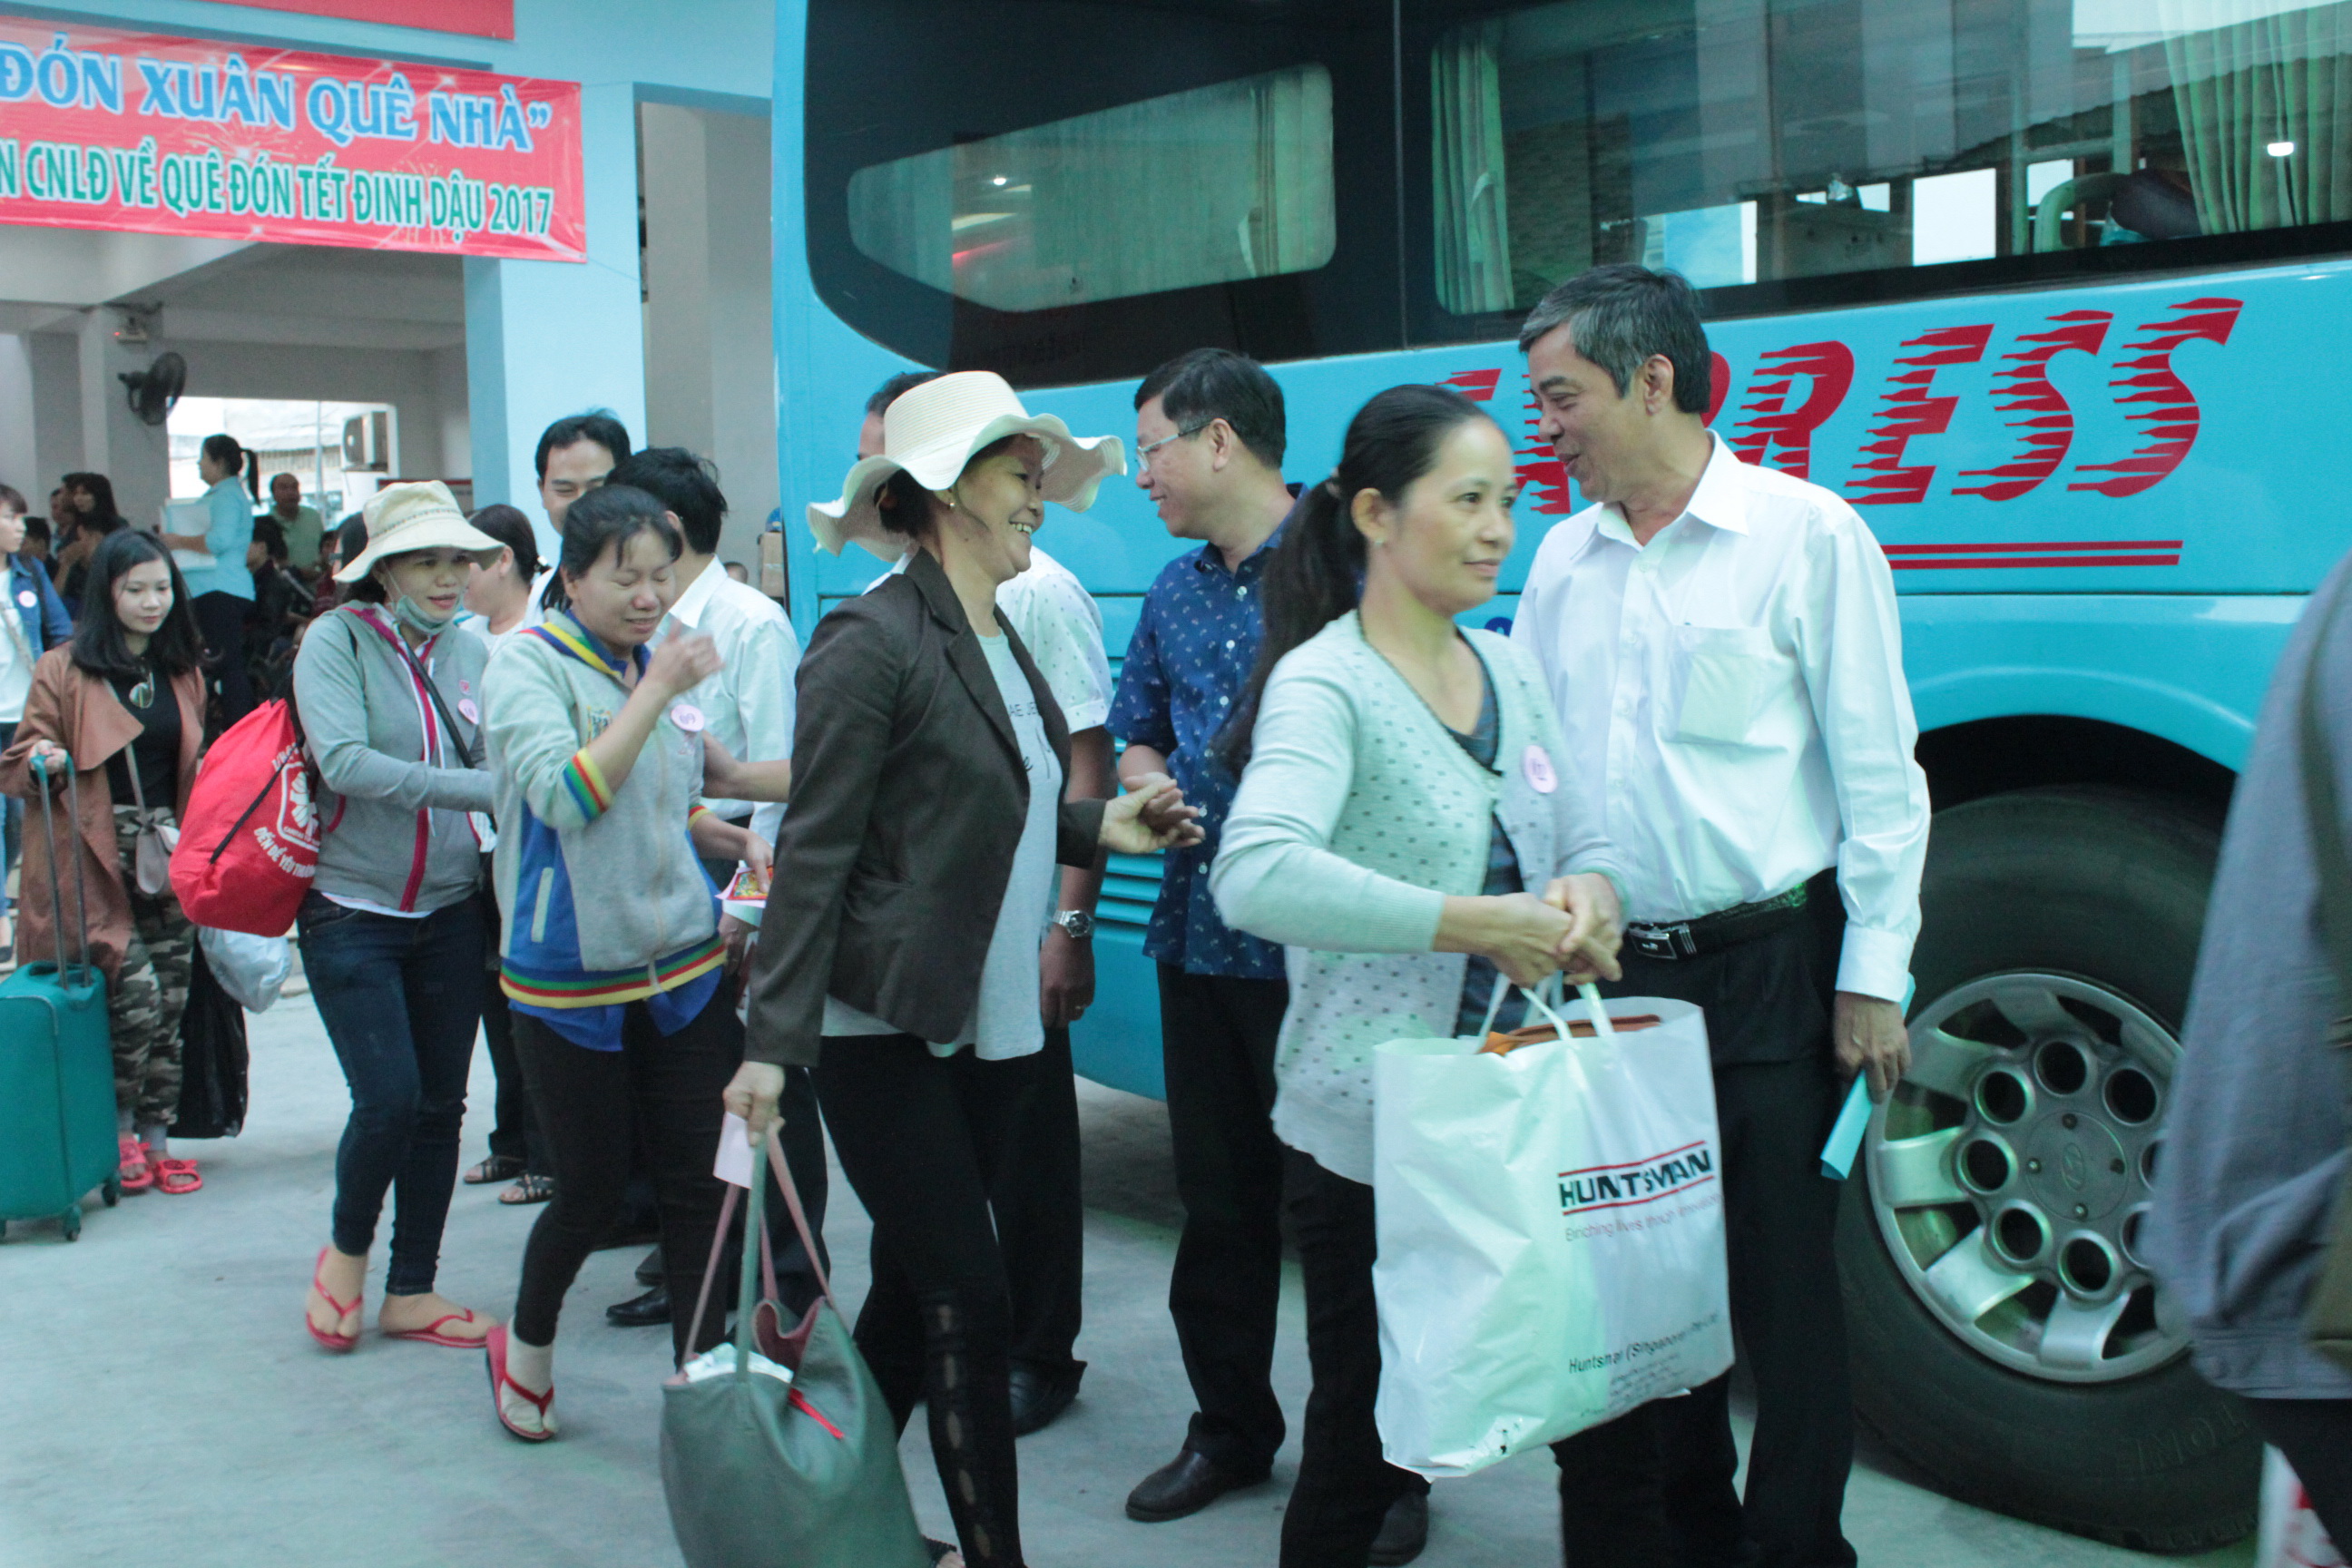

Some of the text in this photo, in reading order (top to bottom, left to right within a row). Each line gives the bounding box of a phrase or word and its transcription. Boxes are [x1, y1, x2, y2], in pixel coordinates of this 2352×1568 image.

[0, 35, 122, 113] ĐÓN
[137, 54, 295, 130] XUÂN
[308, 73, 418, 146] QUÊ
[26, 141, 108, 202] CNLĐ
[114, 137, 158, 206] VỀ
[162, 148, 223, 214] QUÊ
[228, 152, 293, 216] ĐÓN
[298, 152, 348, 220] TẾT
[352, 170, 423, 226] ĐINH
[430, 170, 483, 241] DẬU
[488, 184, 553, 235] 2017
[1434, 297, 2245, 515] RESS
[1558, 1149, 1714, 1208] HUNTSMAN
